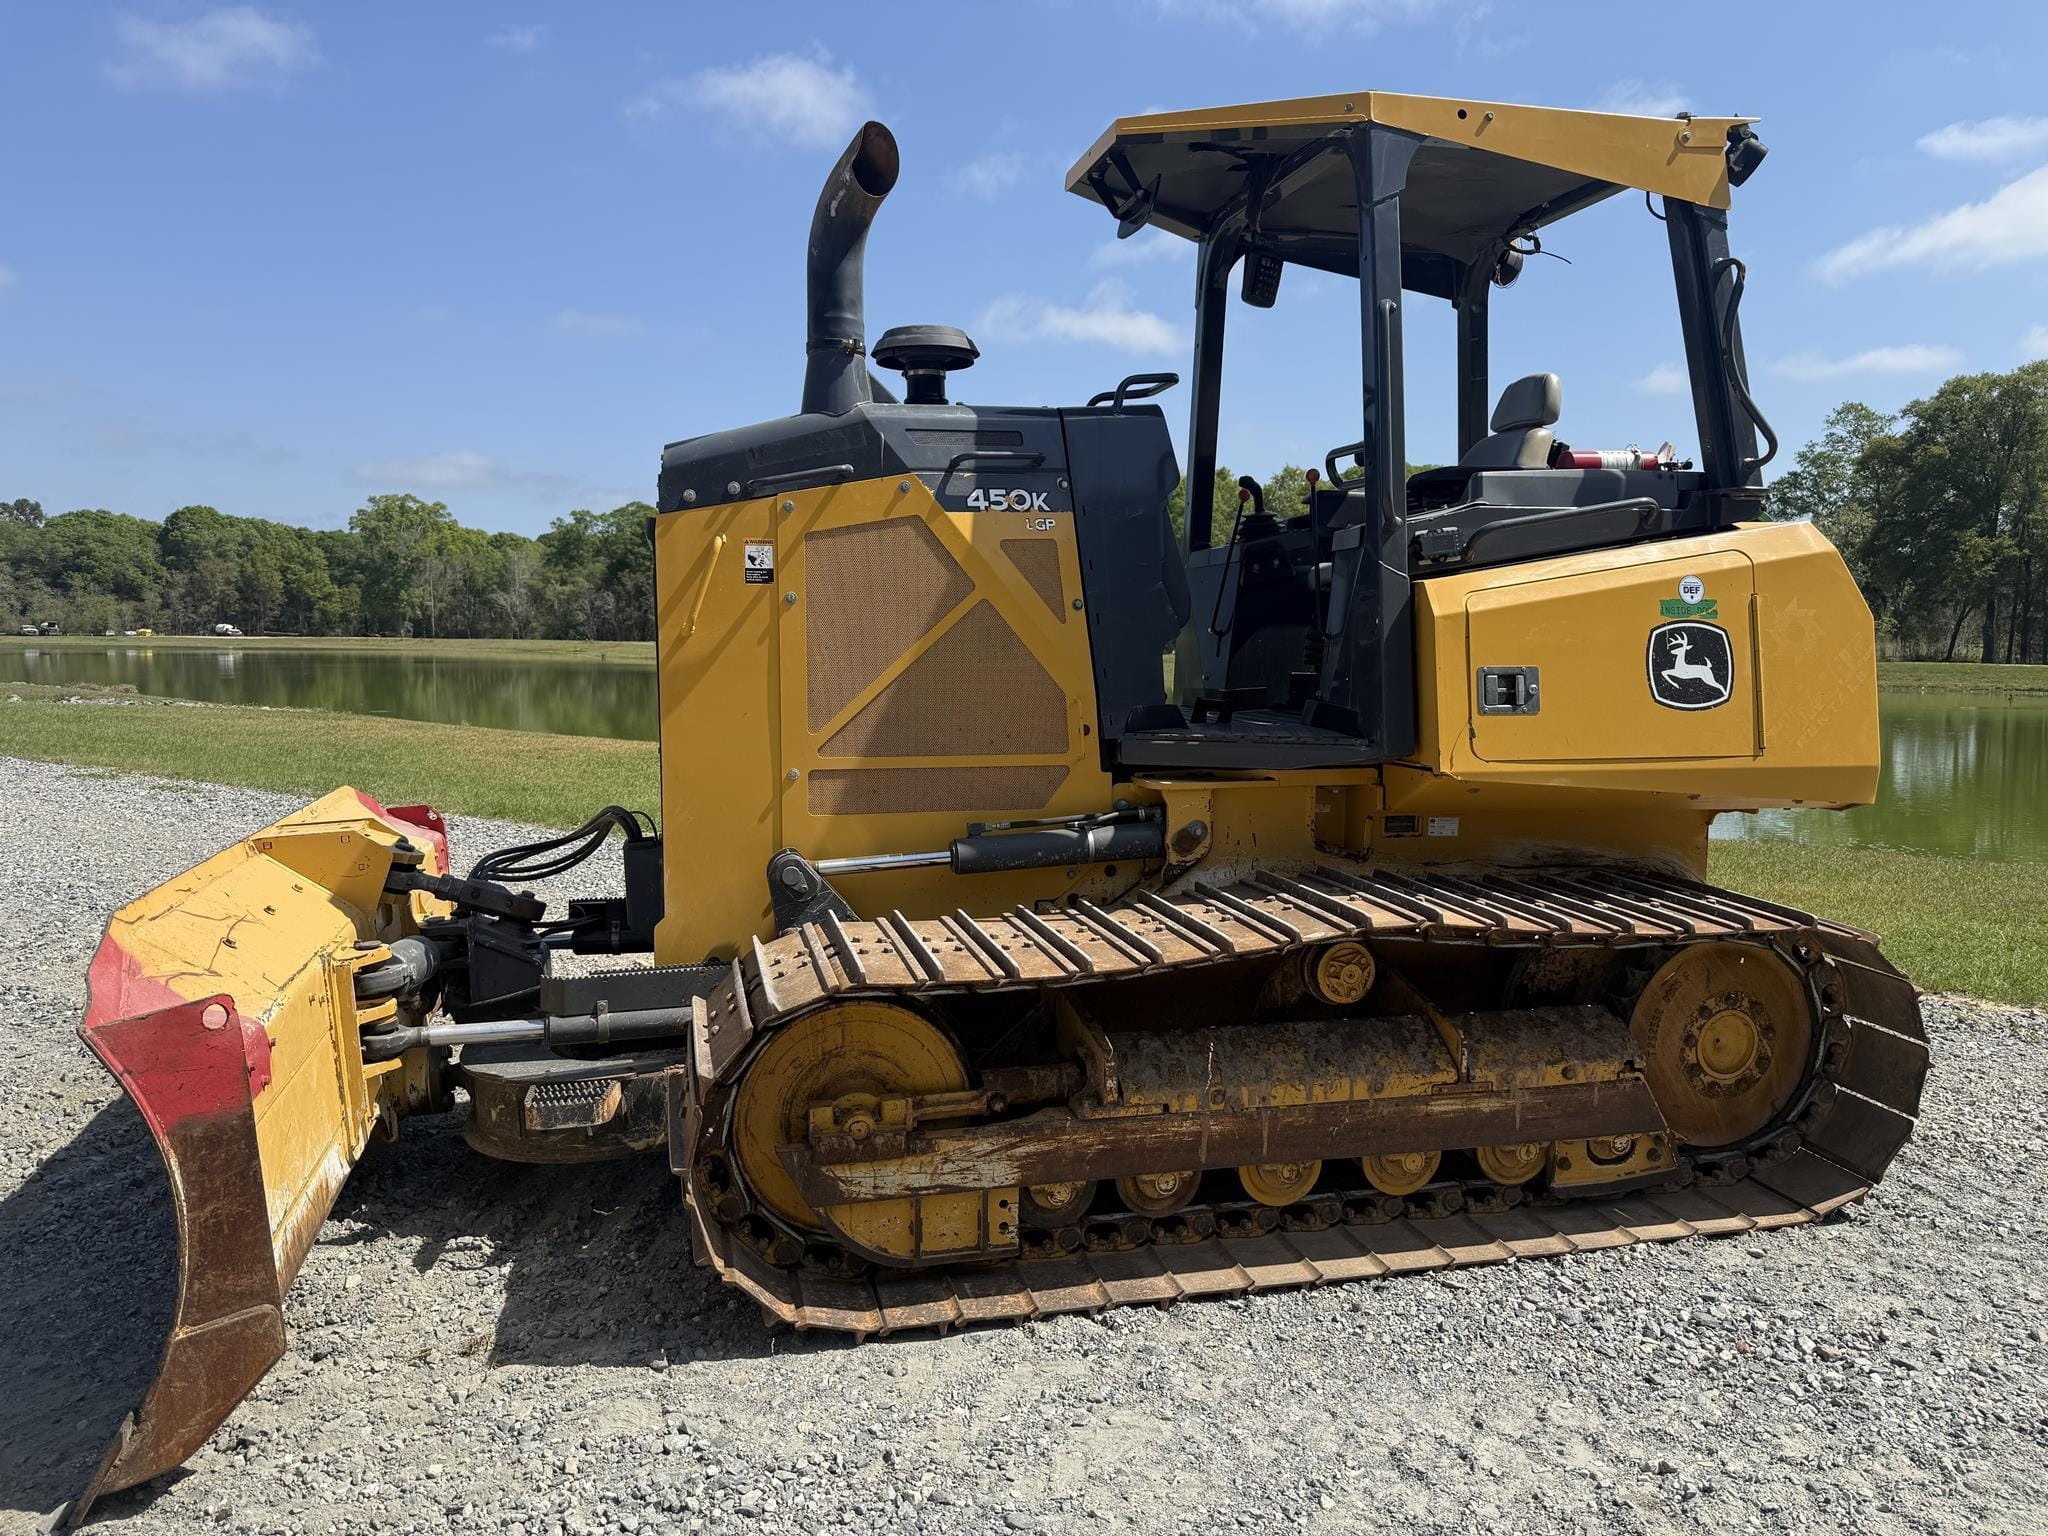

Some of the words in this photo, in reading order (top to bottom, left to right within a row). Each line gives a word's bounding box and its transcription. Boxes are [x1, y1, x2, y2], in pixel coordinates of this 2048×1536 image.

[967, 488, 1051, 511] 450K
[1026, 519, 1055, 531] LGP
[1683, 586, 1701, 595] DEF
